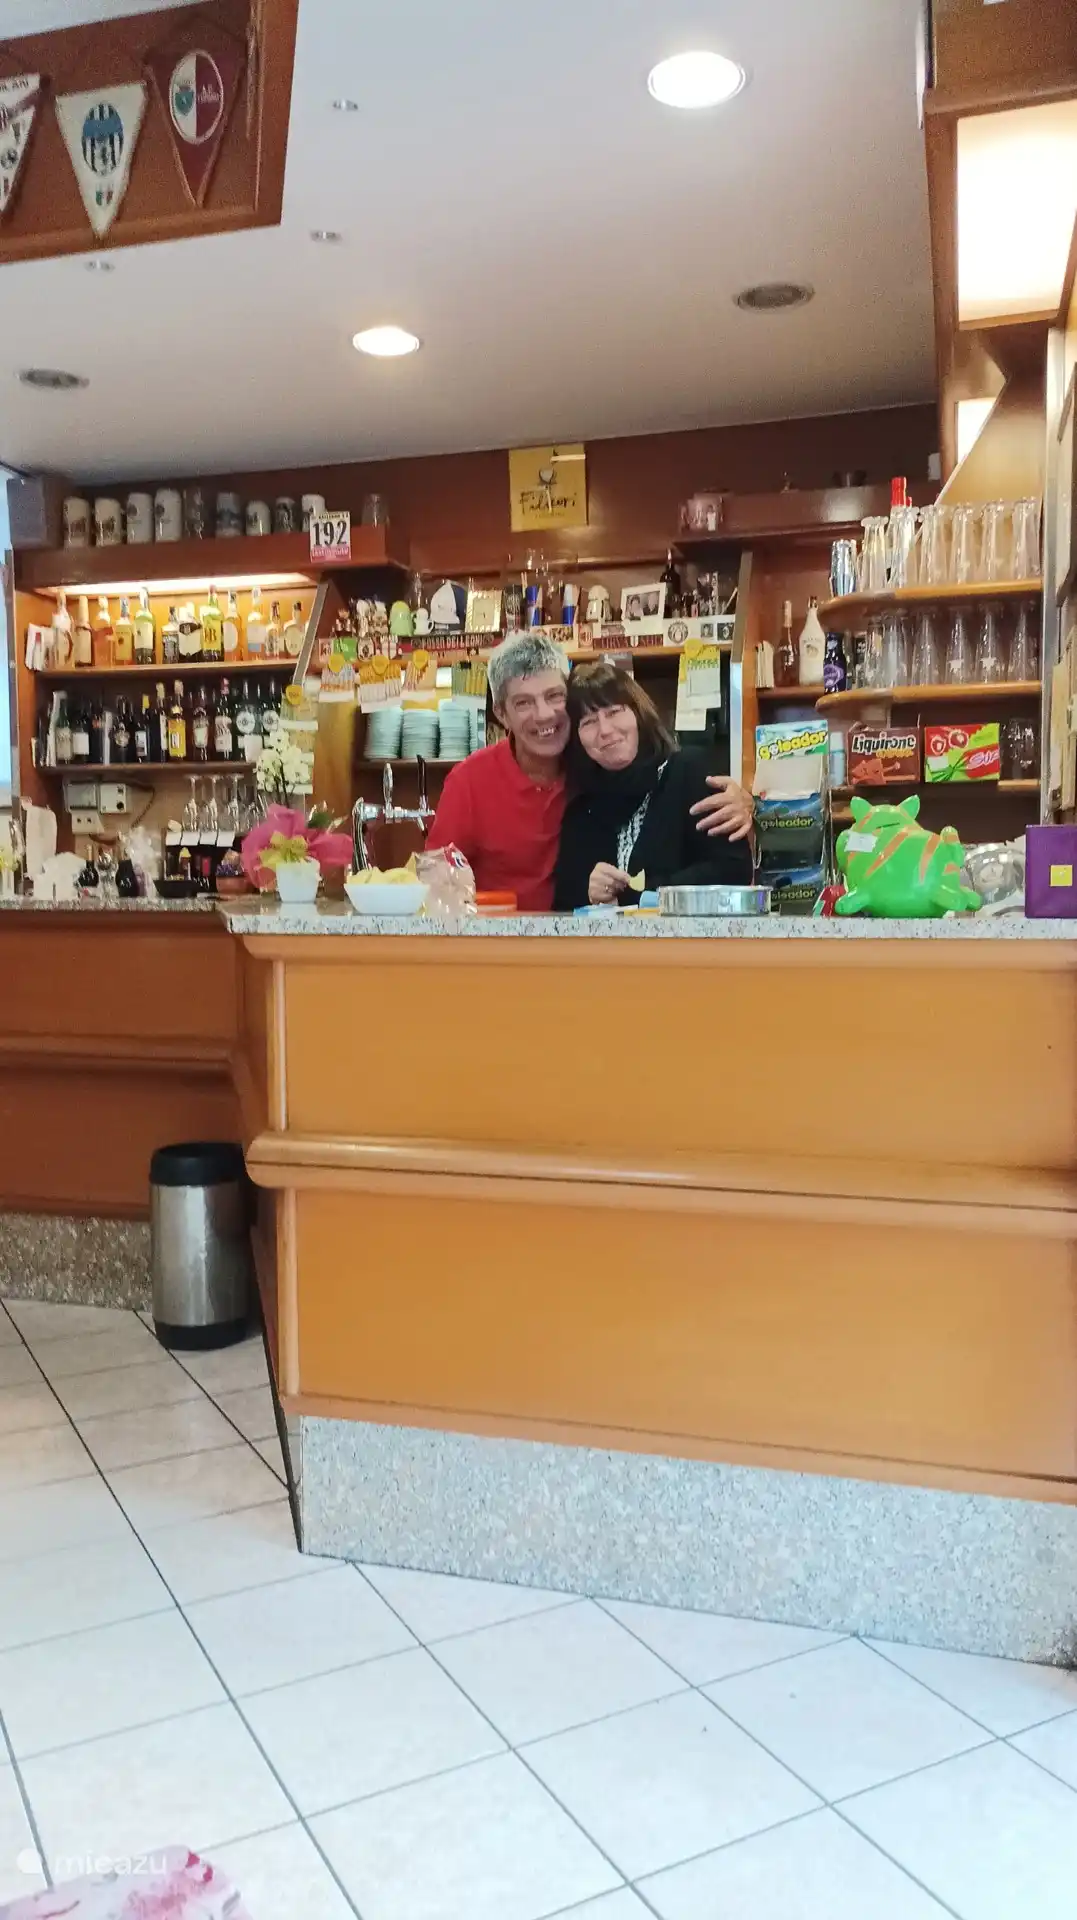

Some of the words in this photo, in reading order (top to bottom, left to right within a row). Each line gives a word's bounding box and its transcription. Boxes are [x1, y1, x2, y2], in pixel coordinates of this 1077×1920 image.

[312, 520, 348, 547] 192
[759, 731, 827, 760] goleador
[760, 817, 815, 832] goleador
